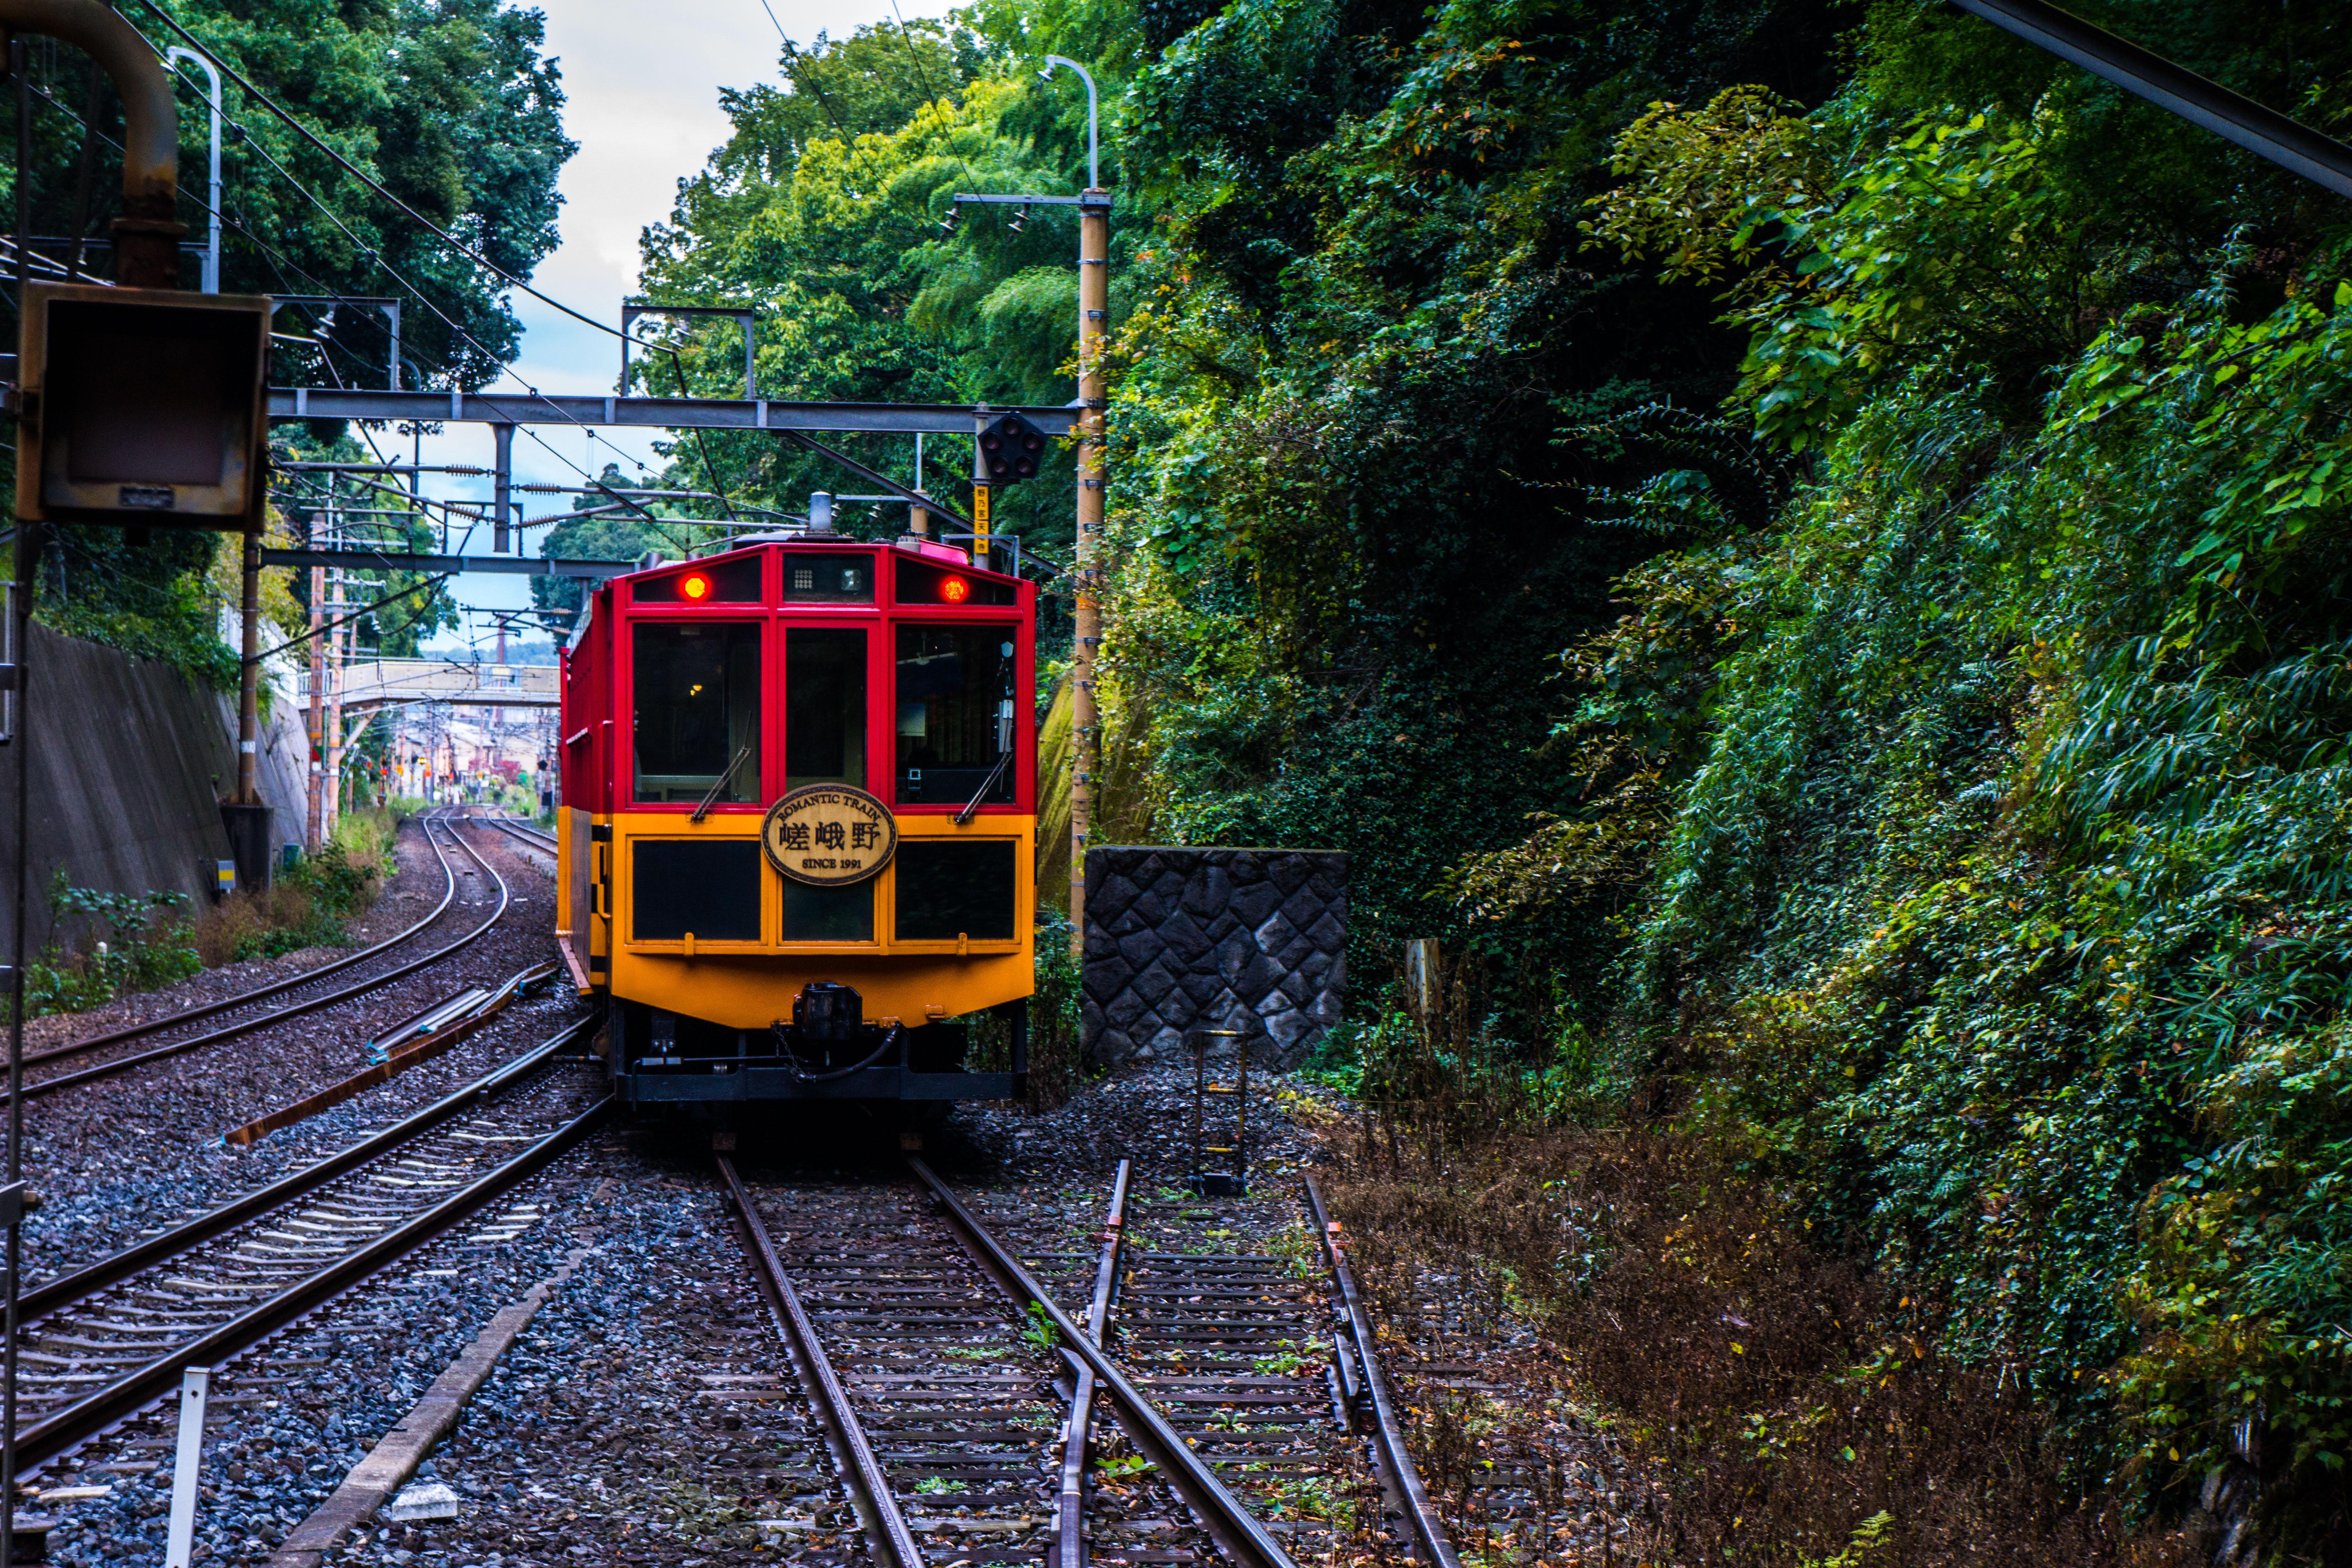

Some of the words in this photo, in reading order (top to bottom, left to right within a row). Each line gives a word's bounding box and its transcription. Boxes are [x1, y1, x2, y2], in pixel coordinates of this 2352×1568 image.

[777, 794, 840, 822] ROMANTIC
[842, 795, 881, 822] TRAIN
[779, 821, 880, 850] 嵯峨野
[802, 858, 837, 869] SINCE
[840, 859, 862, 869] 1991
